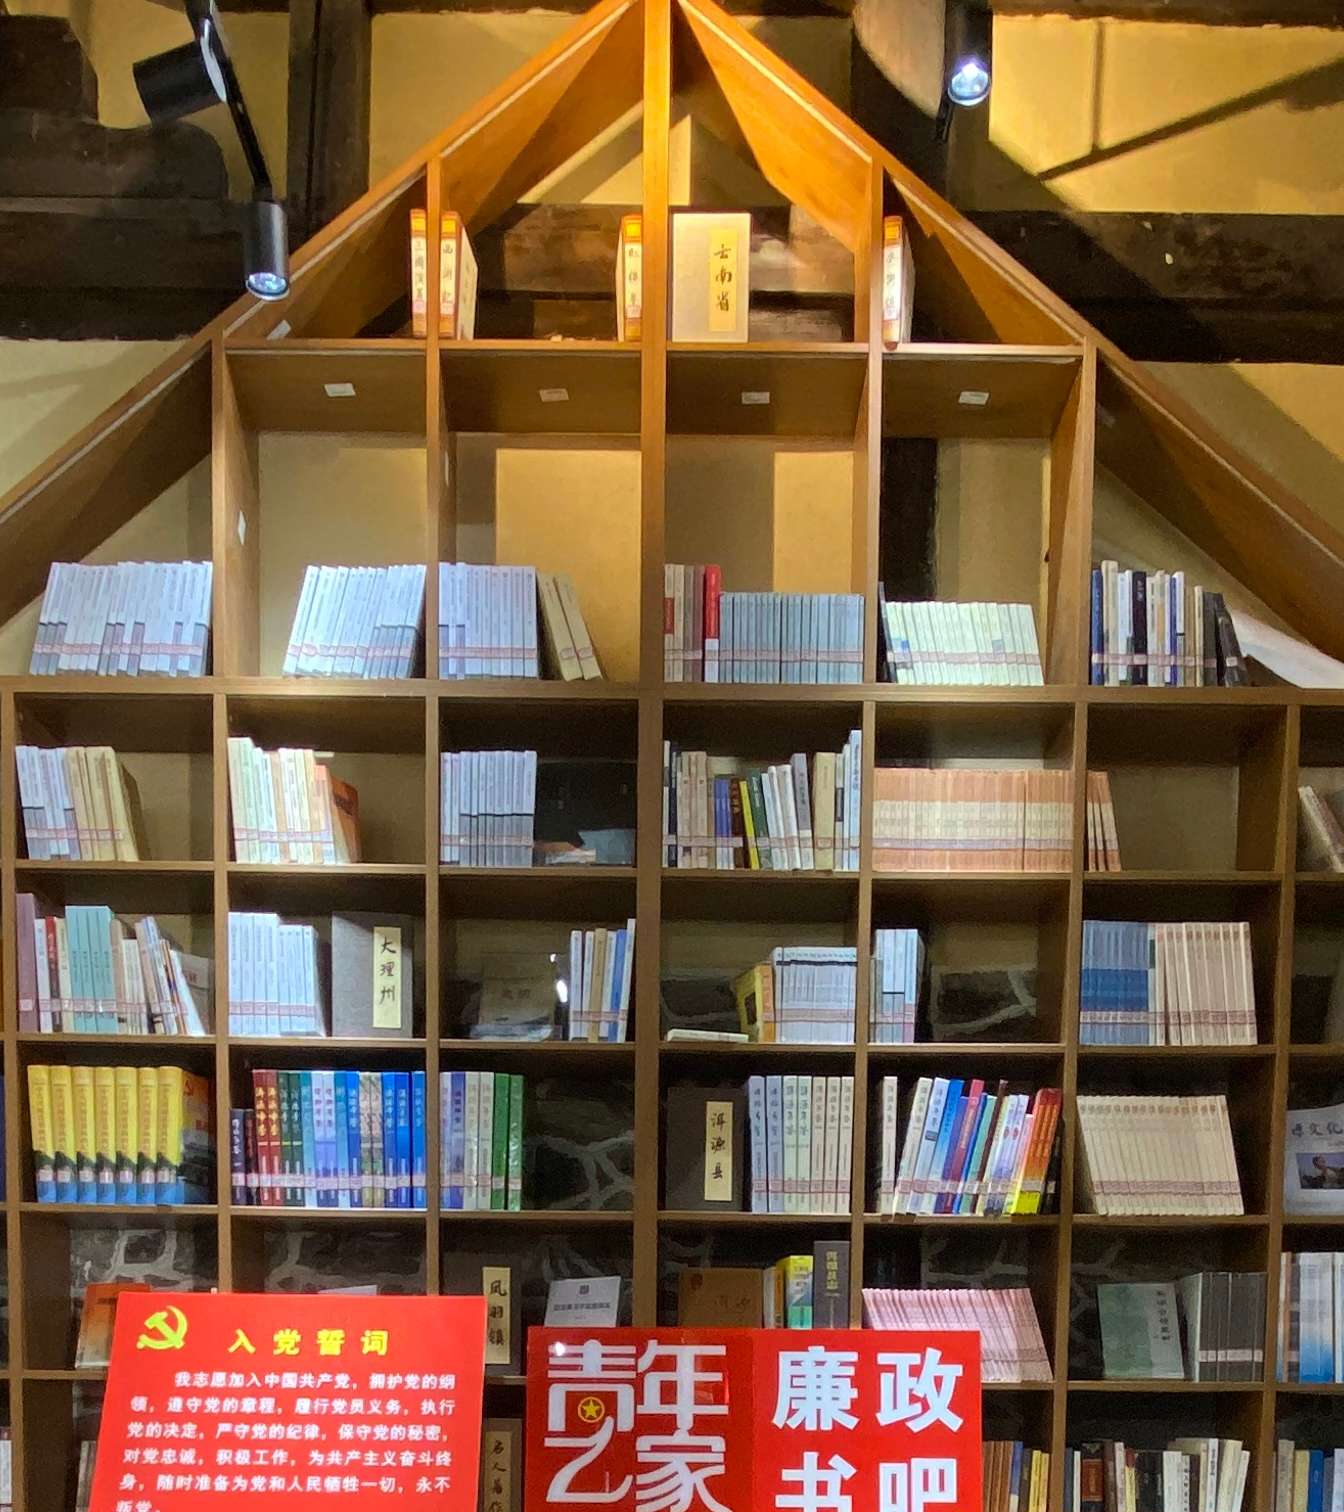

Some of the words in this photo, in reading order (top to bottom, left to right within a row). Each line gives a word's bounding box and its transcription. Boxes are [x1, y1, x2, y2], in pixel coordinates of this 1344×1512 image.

[713, 244, 733, 312] 云南省
[378, 934, 397, 1004] 大理州
[710, 1111, 727, 1181] 洱源县
[228, 1328, 389, 1357] 入党誓词
[547, 1338, 729, 1432] 青年
[771, 1345, 965, 1433] 廉政
